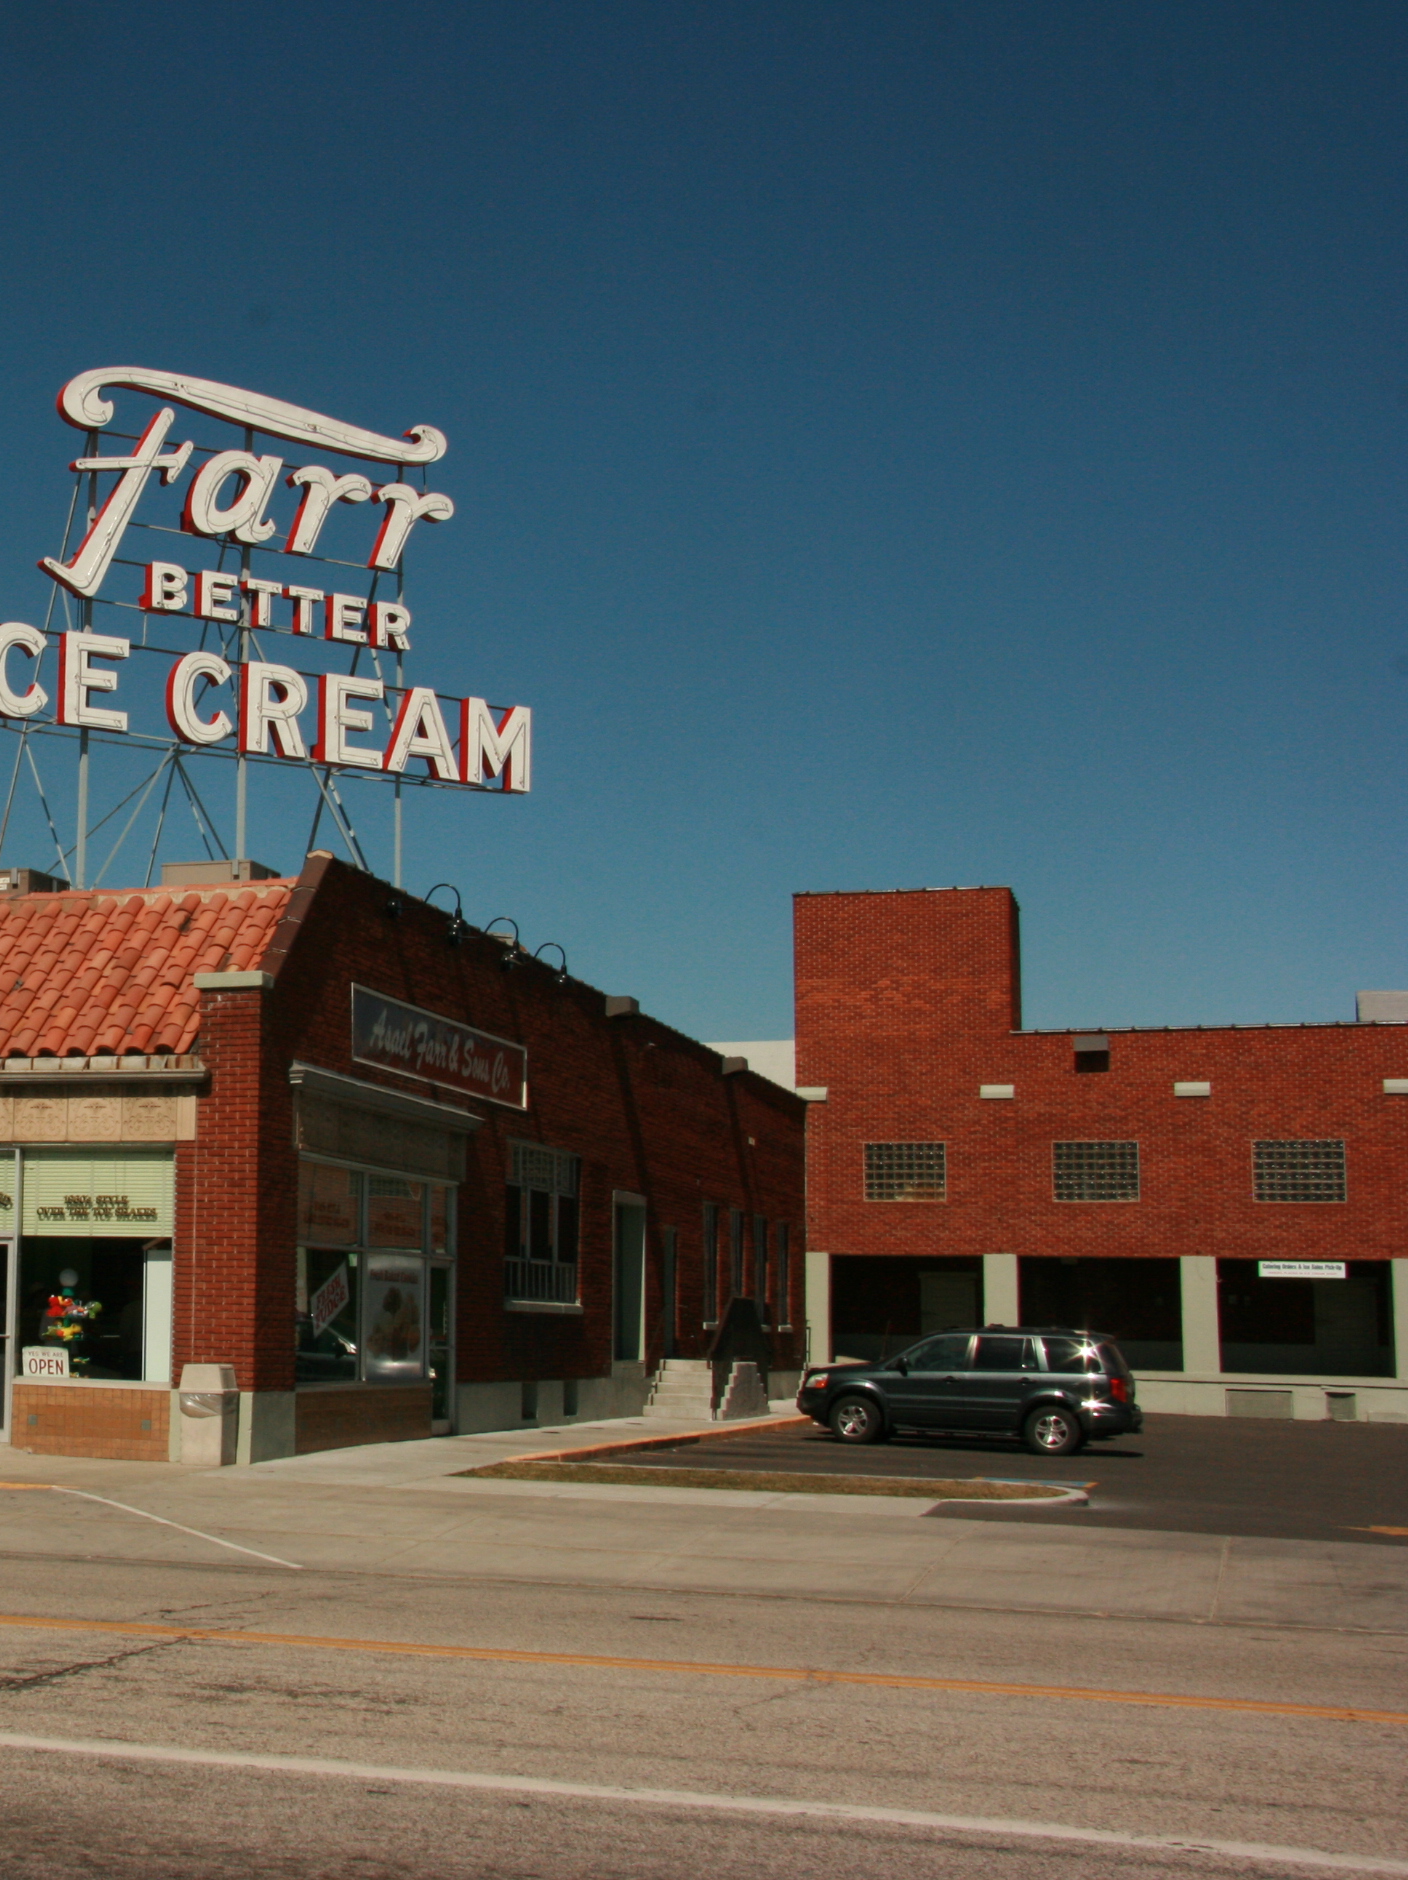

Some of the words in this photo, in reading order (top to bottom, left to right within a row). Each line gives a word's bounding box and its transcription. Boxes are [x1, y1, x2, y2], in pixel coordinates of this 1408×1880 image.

[37, 366, 455, 599] Farr
[139, 561, 411, 651] BETTER
[166, 652, 531, 794] CREAM
[414, 1021, 447, 1070] Farr
[449, 1034, 459, 1072] &
[462, 1038, 489, 1083] Sons
[36, 1207, 65, 1218] OVER
[68, 1207, 89, 1217] THE
[115, 1207, 157, 1218] SHAKES
[95, 1195, 129, 1205] STYLE
[29, 1358, 64, 1375] OPEN
